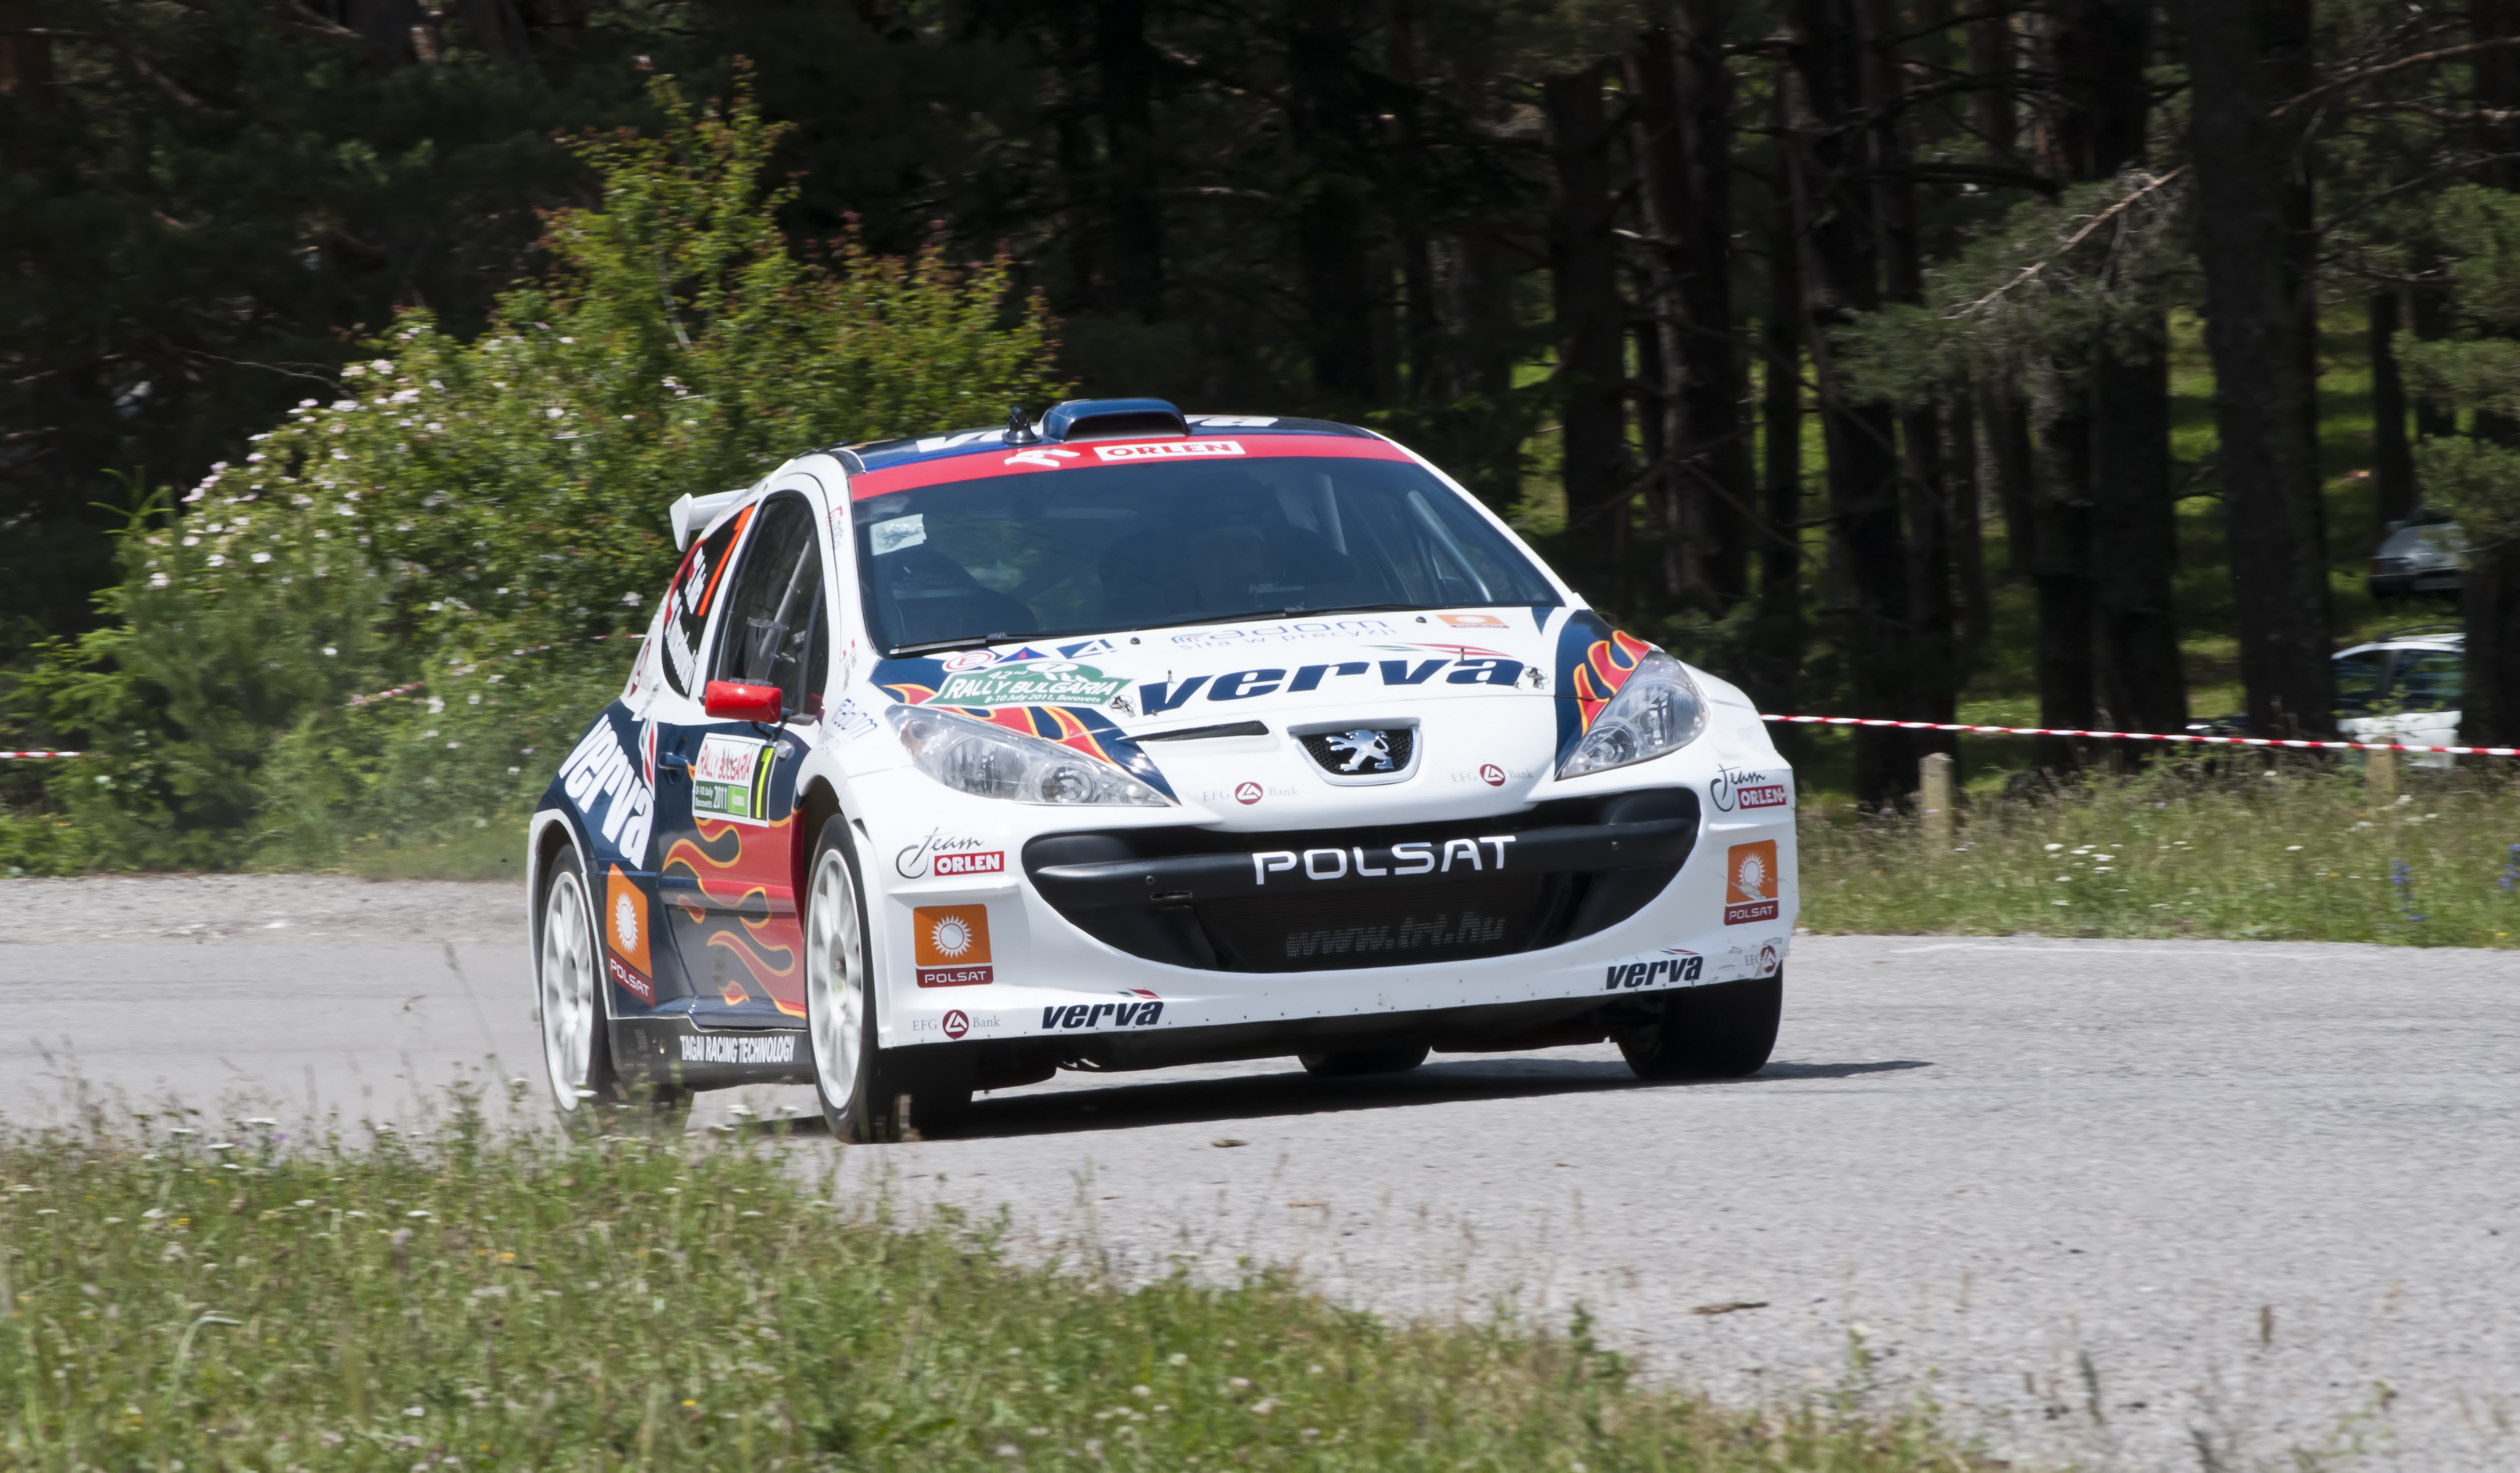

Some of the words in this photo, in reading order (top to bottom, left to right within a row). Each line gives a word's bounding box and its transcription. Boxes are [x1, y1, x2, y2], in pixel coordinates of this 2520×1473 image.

[1106, 443, 1233, 456] ORLEN
[1171, 620, 1388, 643] radom
[957, 656, 976, 666] E
[988, 670, 1028, 679] 42nd
[944, 678, 1012, 699] RALLY
[1008, 680, 1118, 695] BULGARIA
[1138, 658, 1525, 716] verva
[984, 694, 1008, 704] 8-10
[1056, 694, 1101, 702] Borovets
[697, 743, 719, 778] RALLY
[1450, 772, 1477, 783] EFG
[1508, 769, 1533, 778] Bank
[559, 714, 654, 870] verva
[1203, 790, 1230, 801] EFG
[1269, 786, 1298, 796] Bank
[1740, 787, 1784, 806] ORLEN
[936, 854, 1000, 874] ORLEN
[1252, 836, 1516, 885] POLSAT
[1729, 905, 1775, 921] POLSAT
[610, 958, 650, 997] POLSAT
[925, 971, 986, 984] POLSAT
[1606, 955, 1704, 990] verva
[912, 1019, 938, 1031] EFG
[972, 1015, 1001, 1028] Bank
[1042, 1000, 1164, 1030] verva
[679, 1036, 705, 1061] TAGAI
[706, 1036, 738, 1063] RACING
[738, 1036, 795, 1063] TECHNOLOGY
